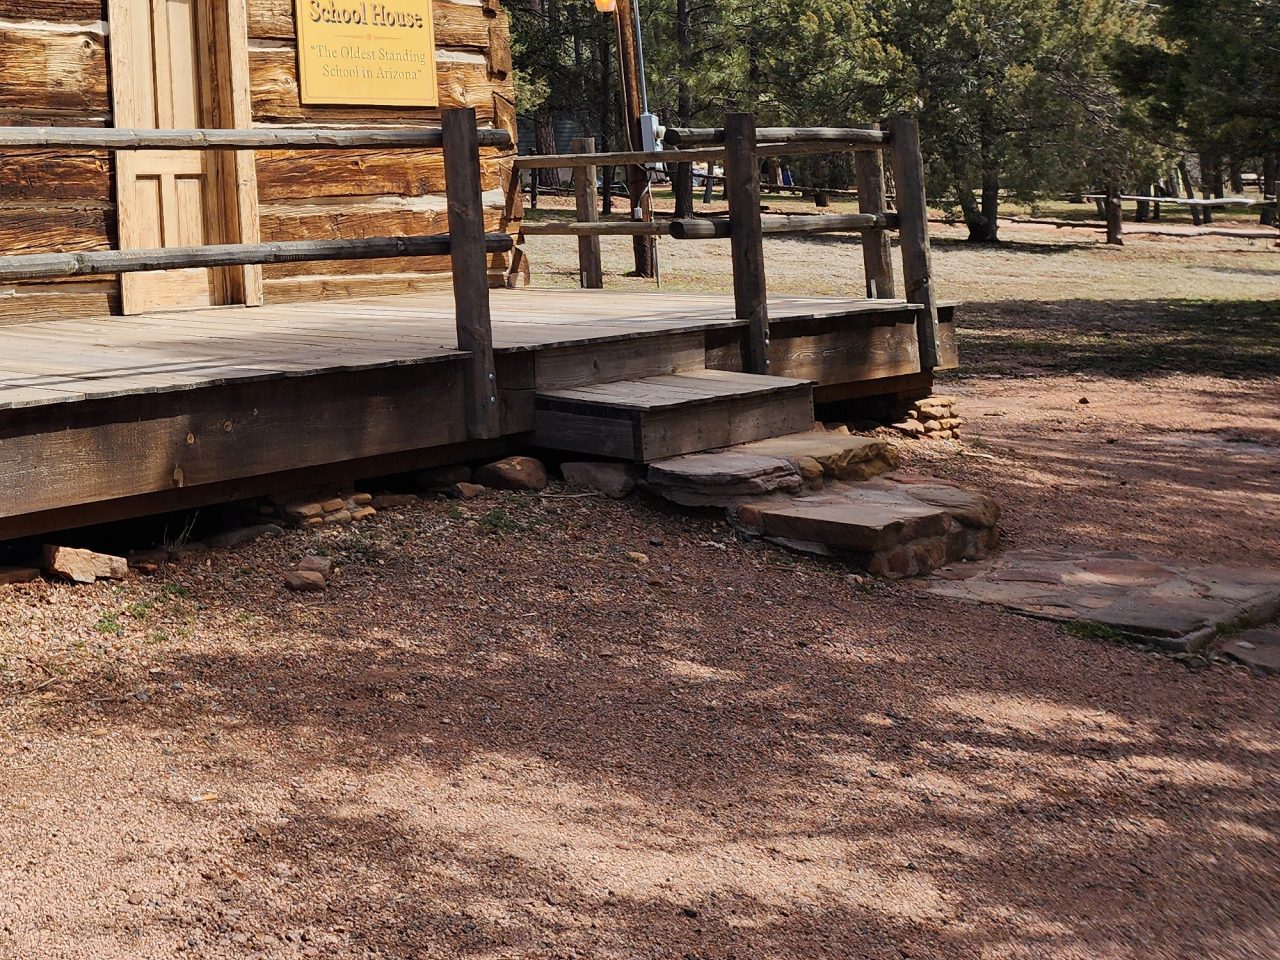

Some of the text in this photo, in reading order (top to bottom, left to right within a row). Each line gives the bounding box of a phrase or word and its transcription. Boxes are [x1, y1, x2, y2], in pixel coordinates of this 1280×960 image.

[309, 0, 424, 28] School House
[340, 46, 375, 60] Oldest
[378, 48, 426, 65] Standing
[322, 64, 359, 78] School
[362, 65, 373, 79] in
